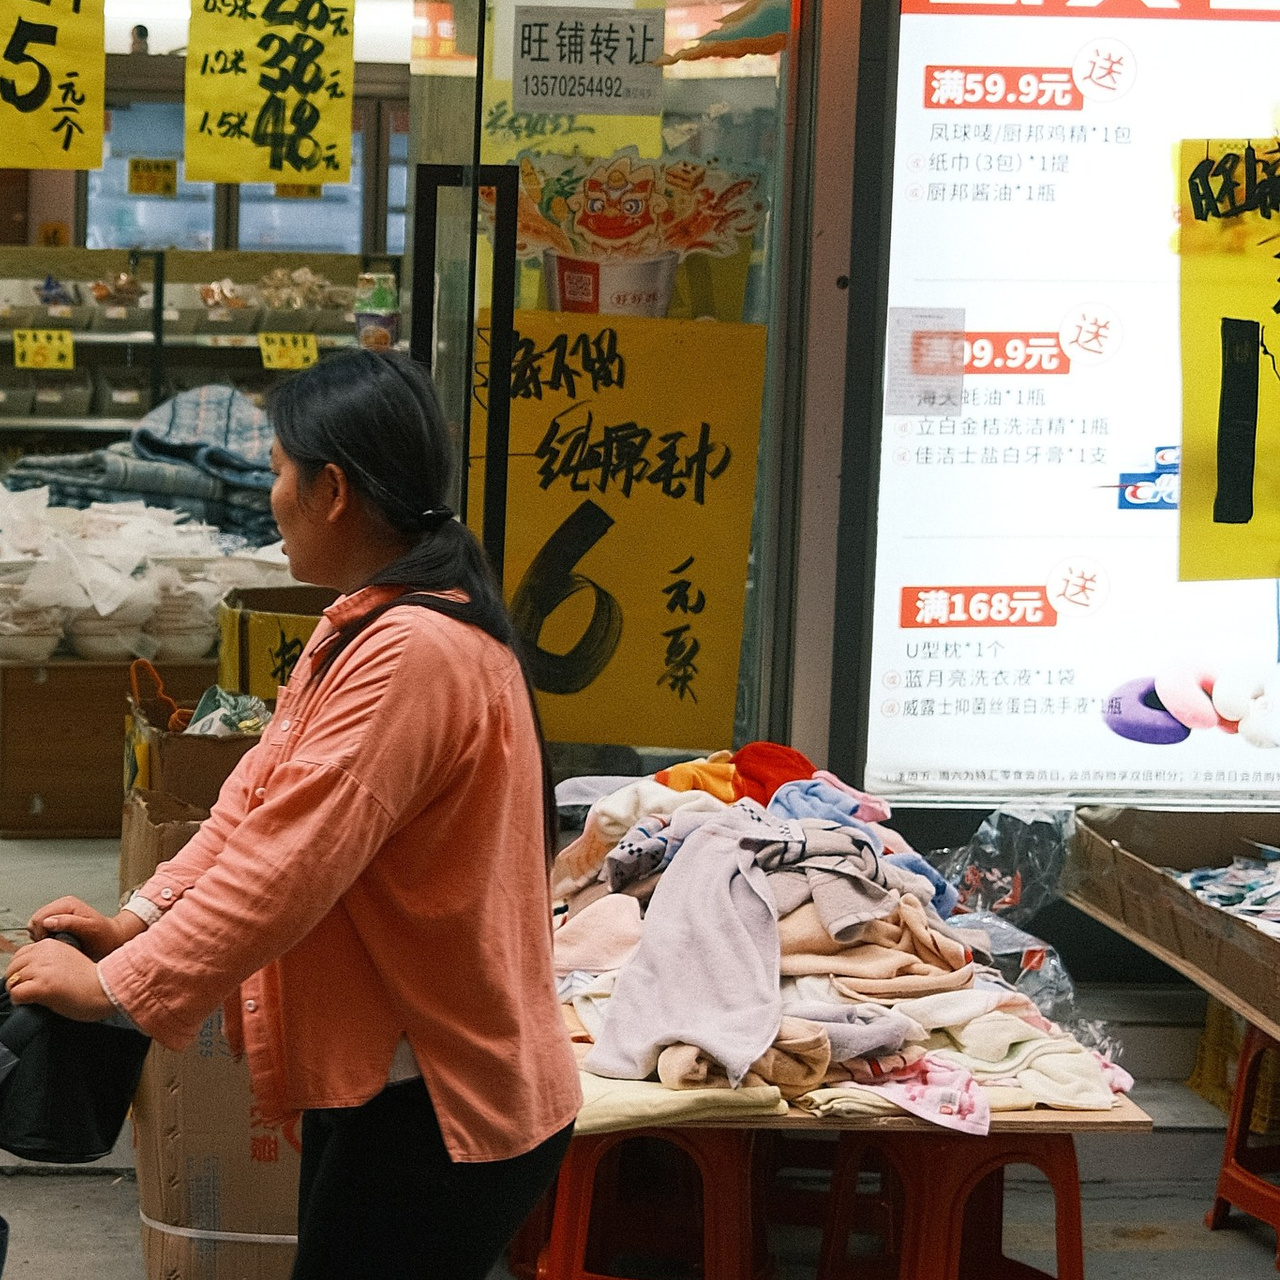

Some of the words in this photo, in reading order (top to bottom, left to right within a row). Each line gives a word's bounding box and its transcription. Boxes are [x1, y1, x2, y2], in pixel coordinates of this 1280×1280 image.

[520, 22, 655, 66] 旺铺转让
[522, 74, 622, 98] 13570254492
[931, 70, 1073, 107] 满59.9元
[915, 590, 1043, 624] 满168元
